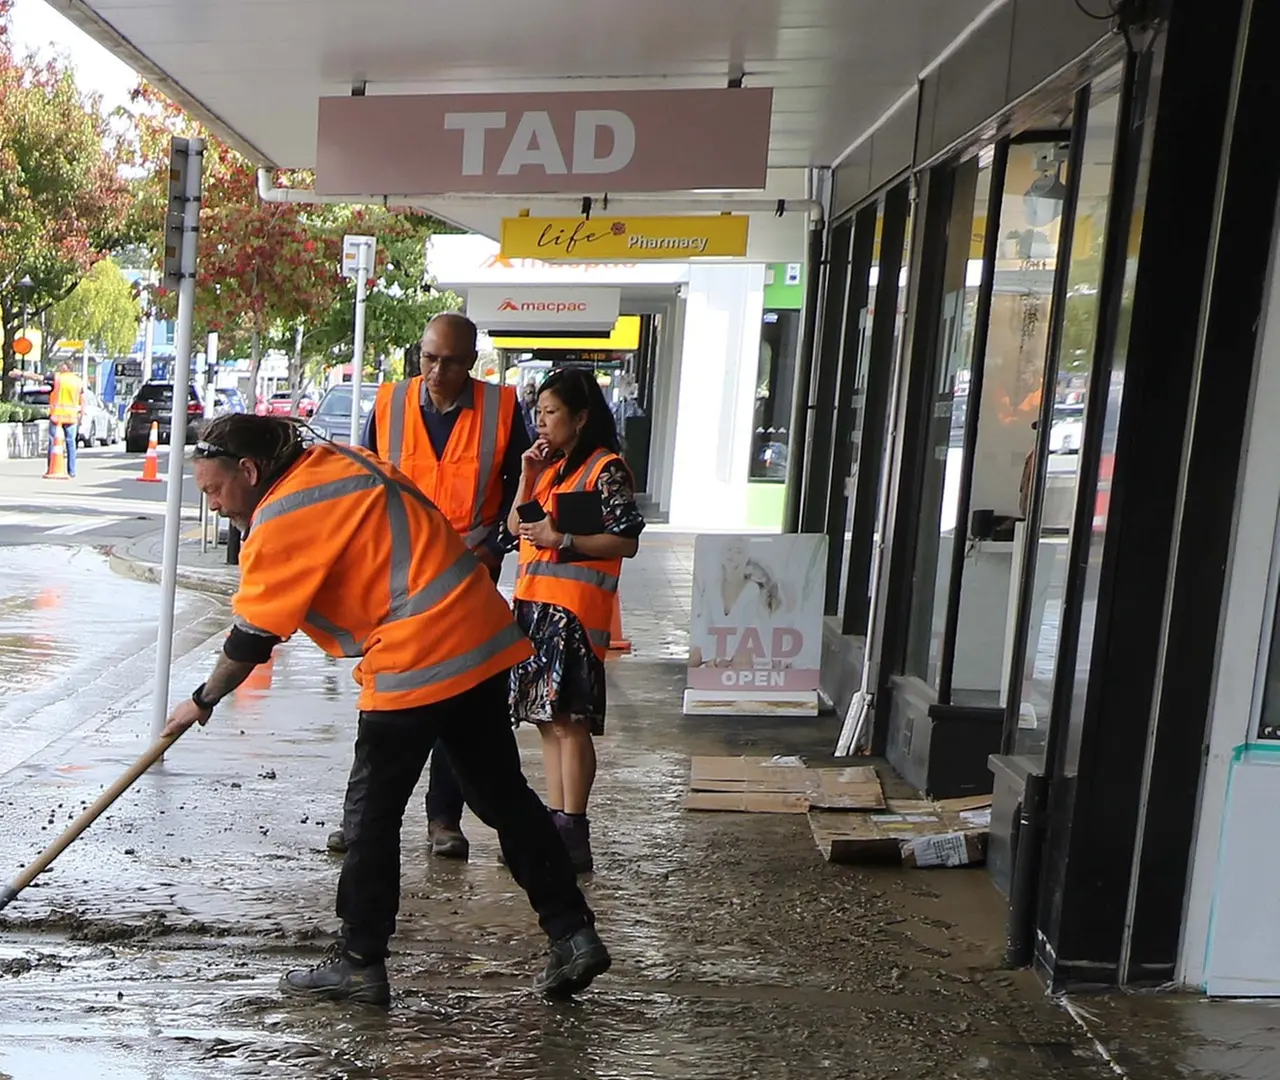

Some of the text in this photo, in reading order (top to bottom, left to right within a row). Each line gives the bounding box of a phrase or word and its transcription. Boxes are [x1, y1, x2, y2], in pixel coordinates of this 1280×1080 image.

[444, 109, 636, 176] TAD
[537, 219, 710, 254] life Pharmacy
[520, 299, 587, 314] macpac
[707, 626, 804, 661] TAD
[721, 670, 786, 687] OPEN
